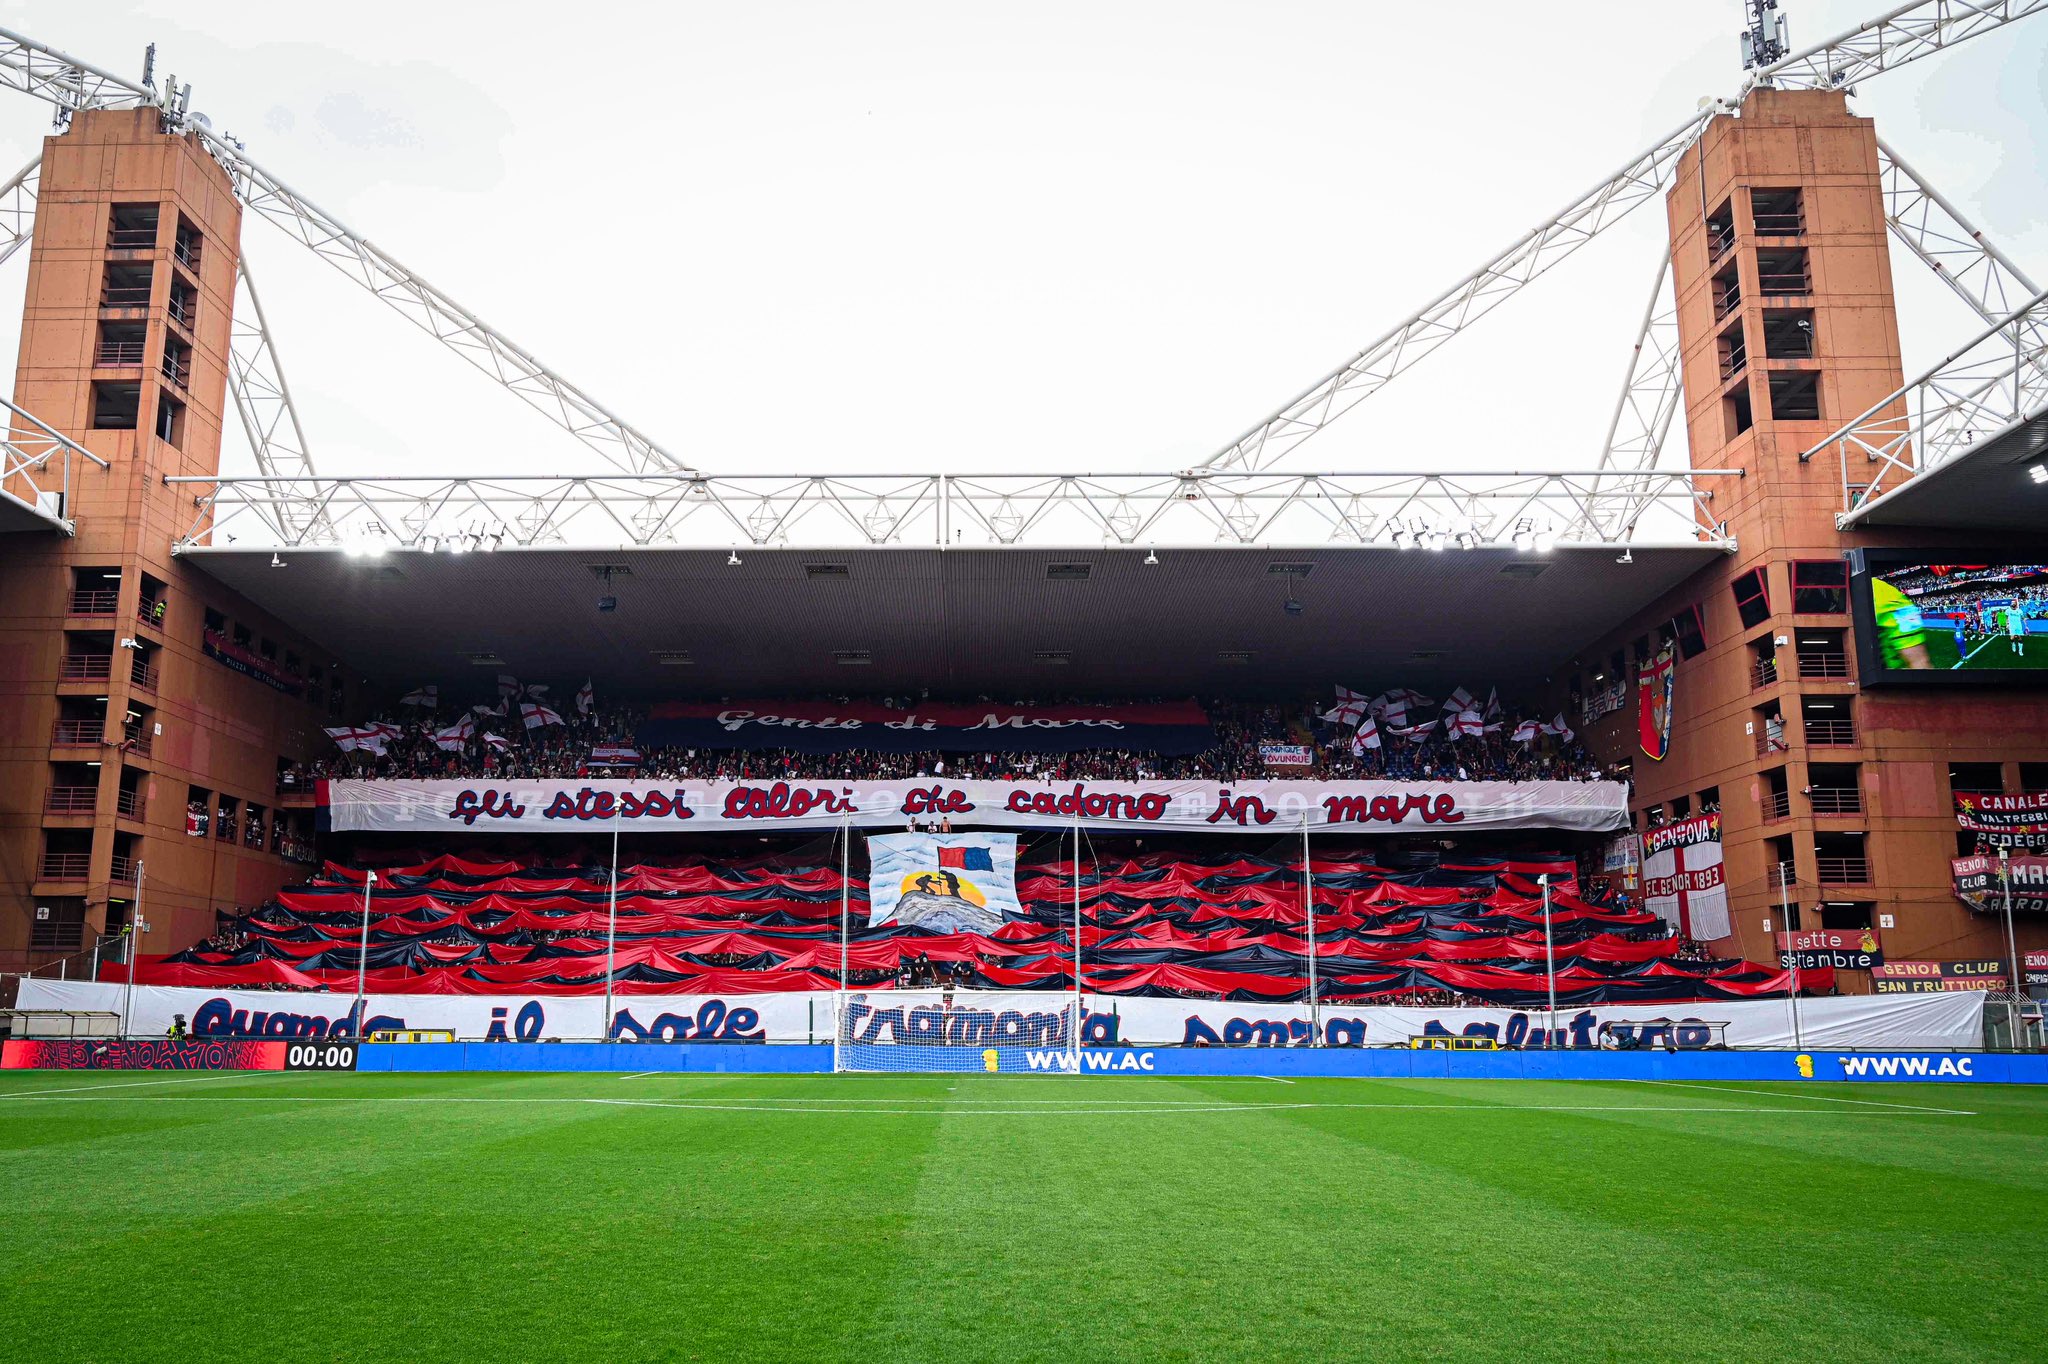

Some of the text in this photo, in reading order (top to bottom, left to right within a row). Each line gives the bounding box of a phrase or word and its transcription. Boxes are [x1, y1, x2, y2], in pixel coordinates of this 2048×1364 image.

[717, 710, 1126, 732] Gente di Mare
[1267, 755, 1310, 763] OVUNQUE
[449, 789, 525, 825] gli
[543, 787, 695, 820] stessi
[901, 784, 976, 815] che
[1004, 783, 1173, 821] cadono
[1205, 789, 1277, 826] in
[1322, 792, 1465, 824] mare
[1653, 819, 1710, 851] GENOVA
[1955, 858, 1989, 872] GENOA
[1694, 867, 1719, 889] 1893
[1961, 875, 1987, 889] CLUB
[1797, 931, 1842, 950] sette
[1781, 951, 1872, 968] settembre
[1884, 962, 1999, 975] GENOA CLUB
[1877, 979, 2006, 993] SAN FRUTTUOSO
[192, 998, 406, 1040] Quando
[484, 1000, 545, 1042] il
[609, 999, 766, 1043] sole
[848, 994, 1121, 1046] tramonta
[289, 1046, 352, 1067] 00:00
[1025, 1051, 1154, 1071] WWW.AC
[1839, 1057, 1973, 1076] WWW.AC
